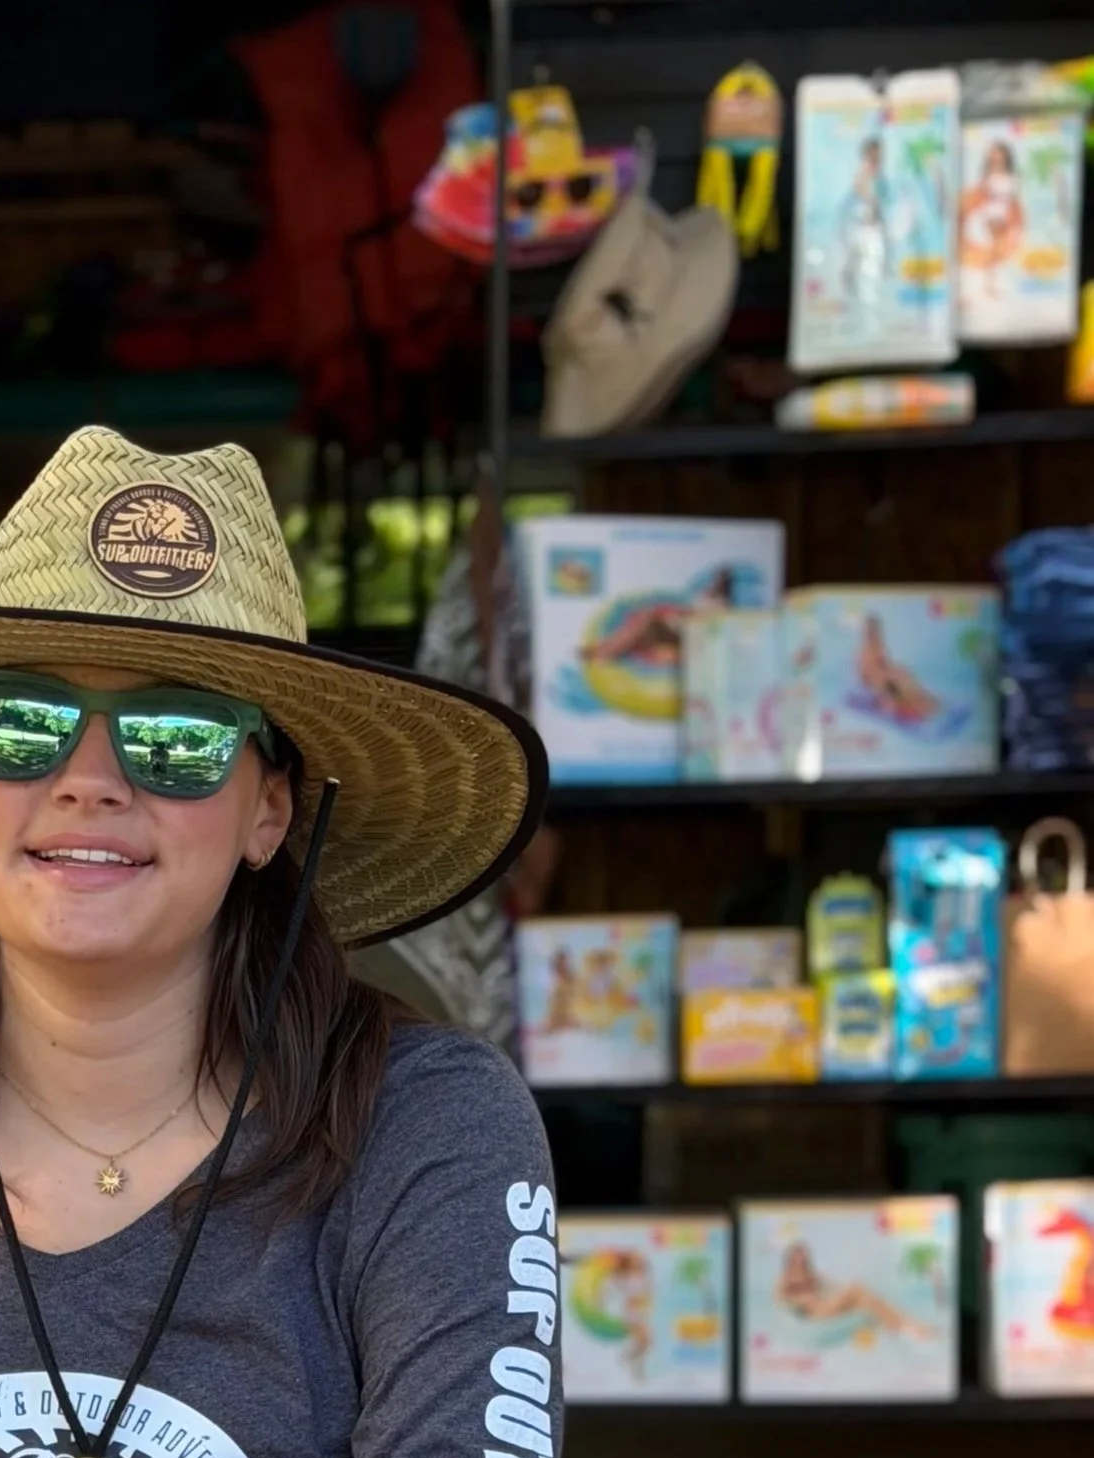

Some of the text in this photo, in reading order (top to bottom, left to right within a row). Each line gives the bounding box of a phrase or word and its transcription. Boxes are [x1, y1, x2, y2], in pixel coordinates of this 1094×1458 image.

[97, 542, 213, 571] SUP OUTFITTERS
[506, 1181, 557, 1347] SUP
[14, 1390, 28, 1417] &
